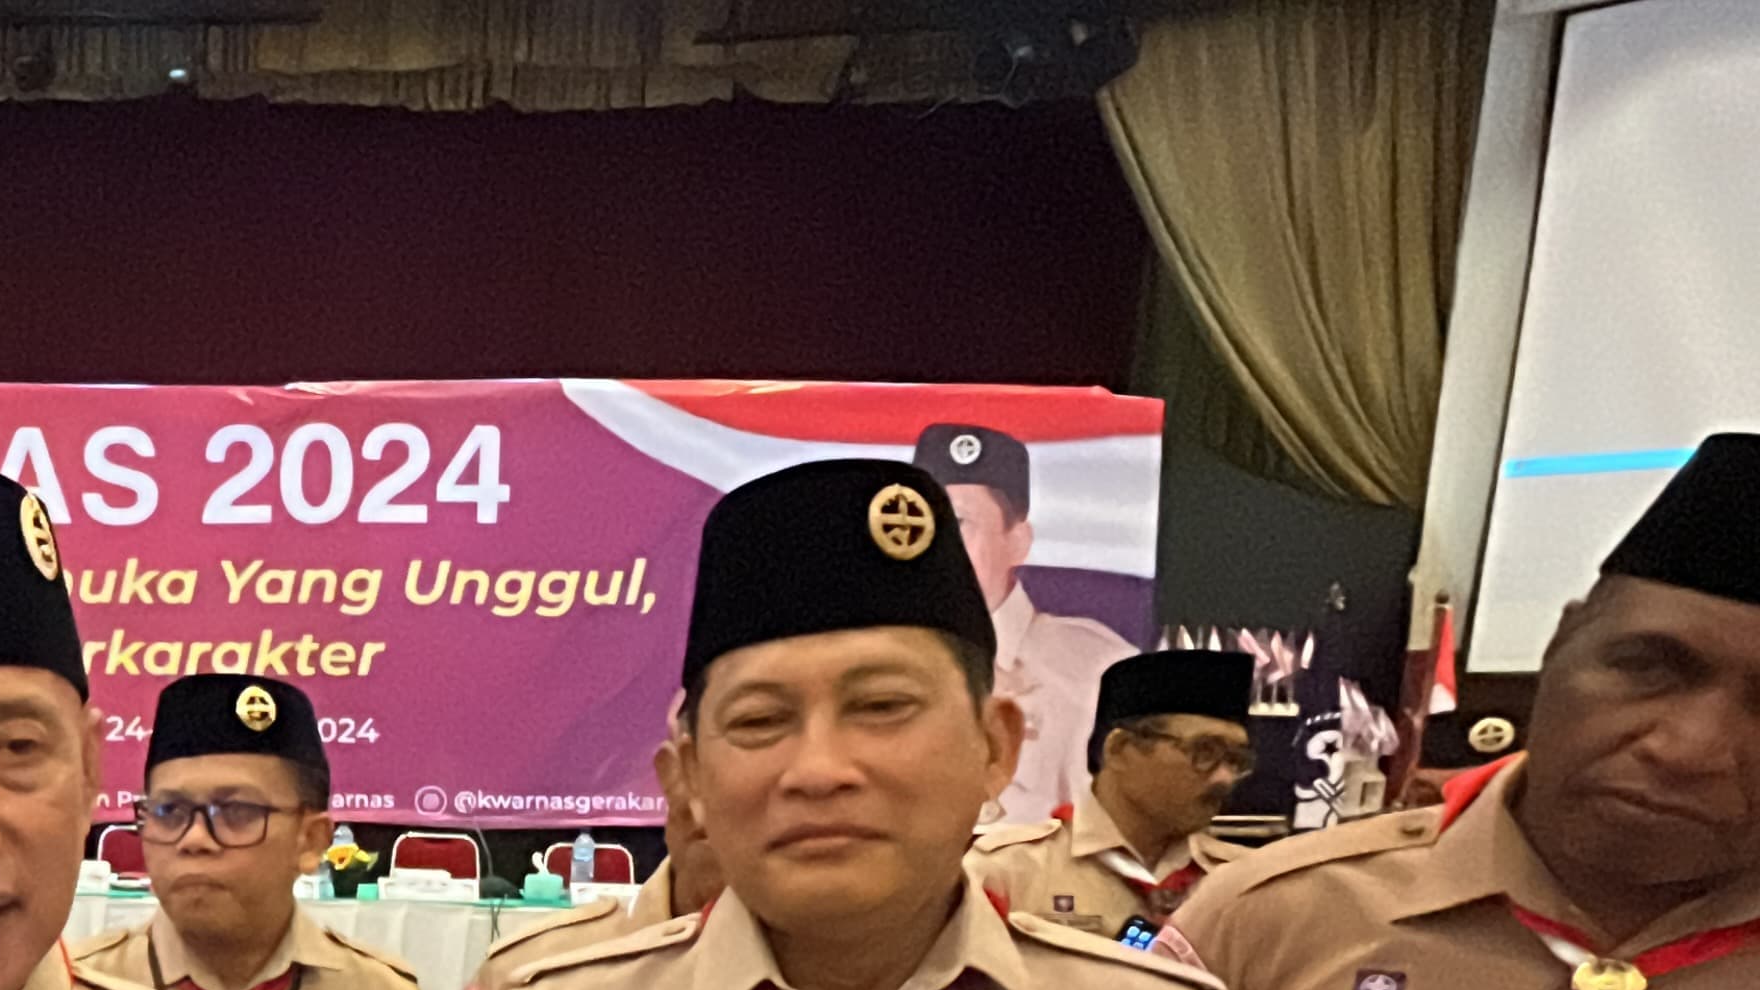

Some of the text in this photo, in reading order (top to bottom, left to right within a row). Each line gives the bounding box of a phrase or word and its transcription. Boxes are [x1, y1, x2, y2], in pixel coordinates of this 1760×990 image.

[202, 423, 510, 524] 2024
[221, 559, 383, 616] Yang
[405, 557, 656, 617] Unggul,
[331, 794, 395, 809] arnas
